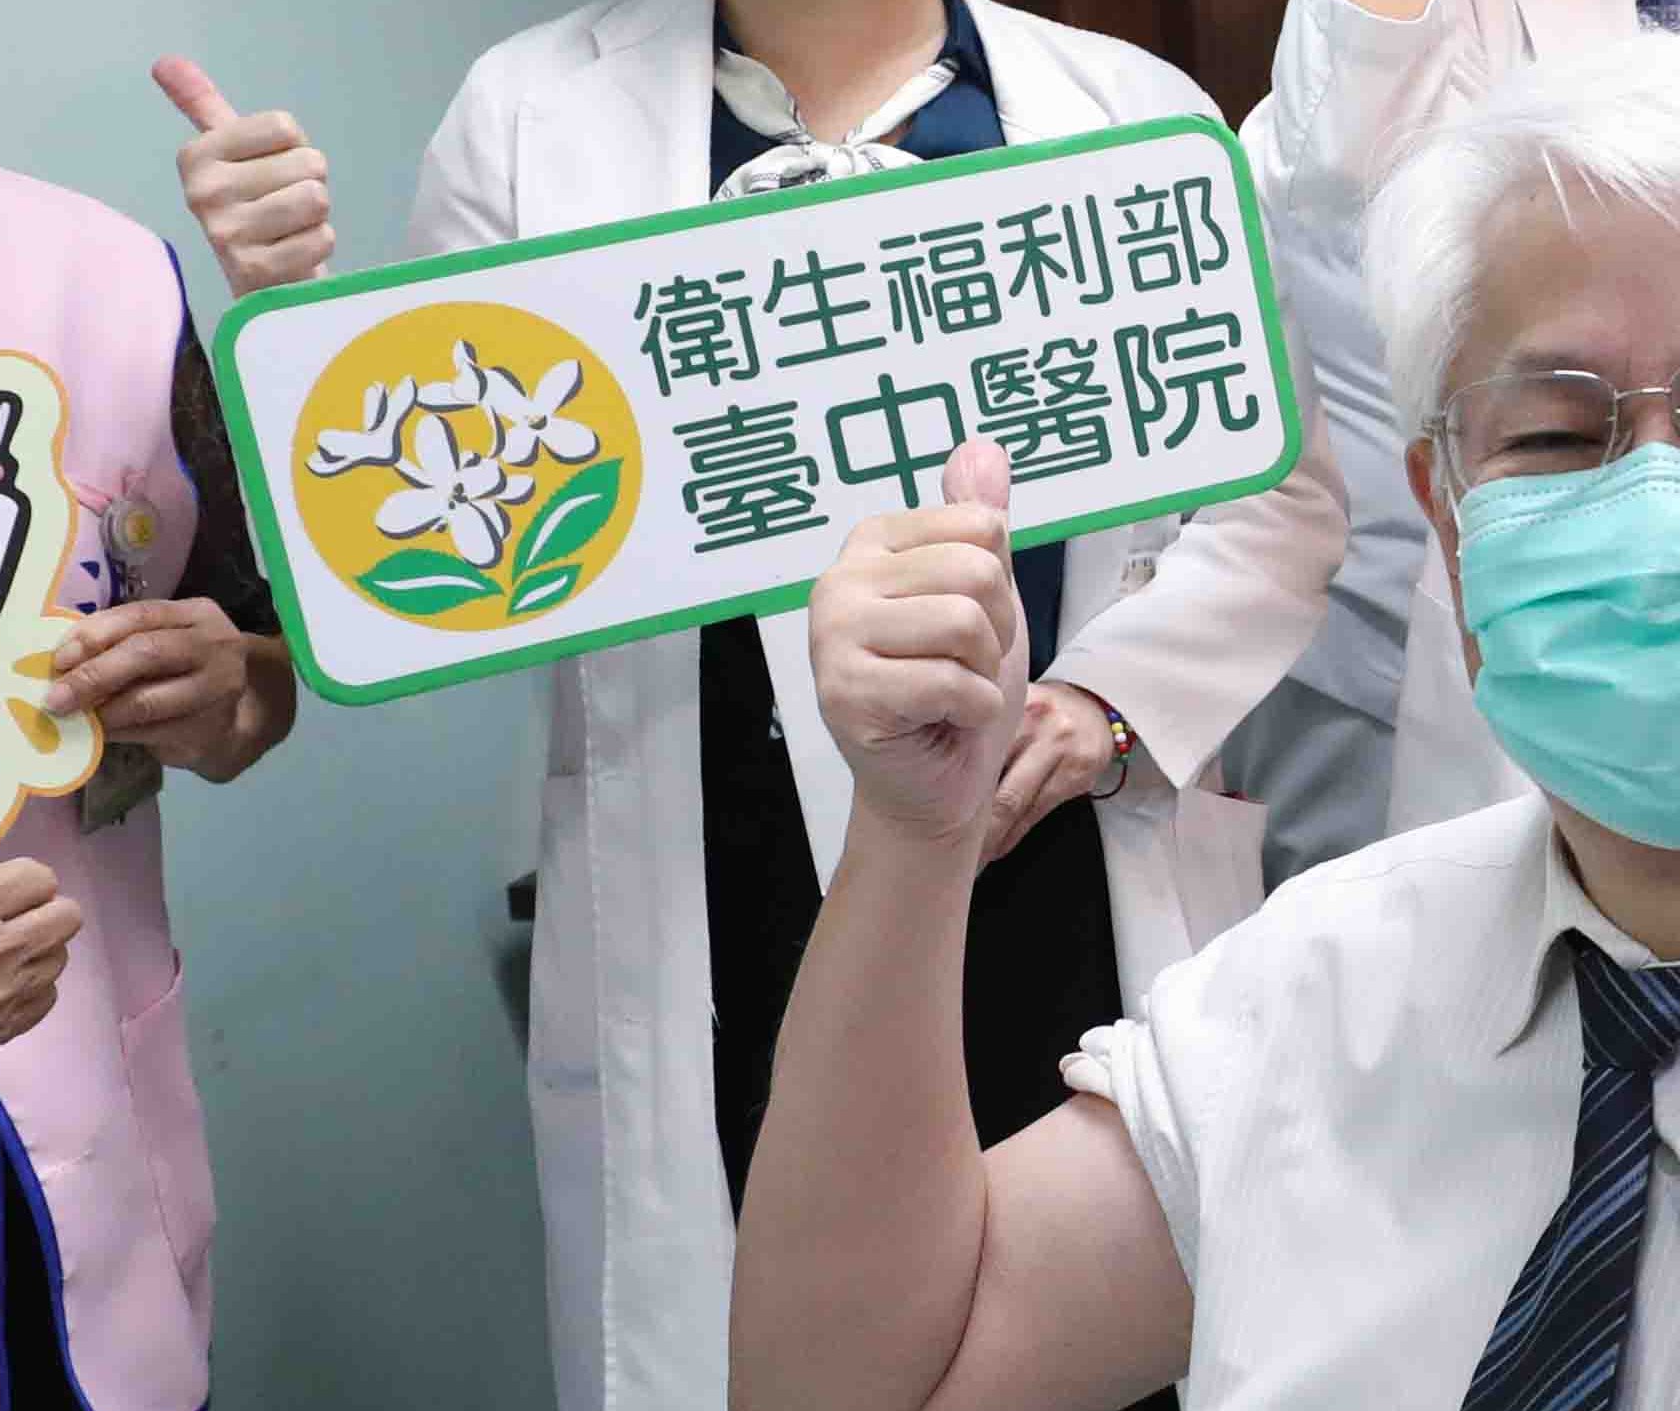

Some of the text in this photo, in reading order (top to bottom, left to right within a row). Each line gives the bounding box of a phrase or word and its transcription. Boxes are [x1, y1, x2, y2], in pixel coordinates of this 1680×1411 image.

[634, 176, 1231, 398] 衛生福利部
[674, 307, 1260, 555] 臺中醫院
